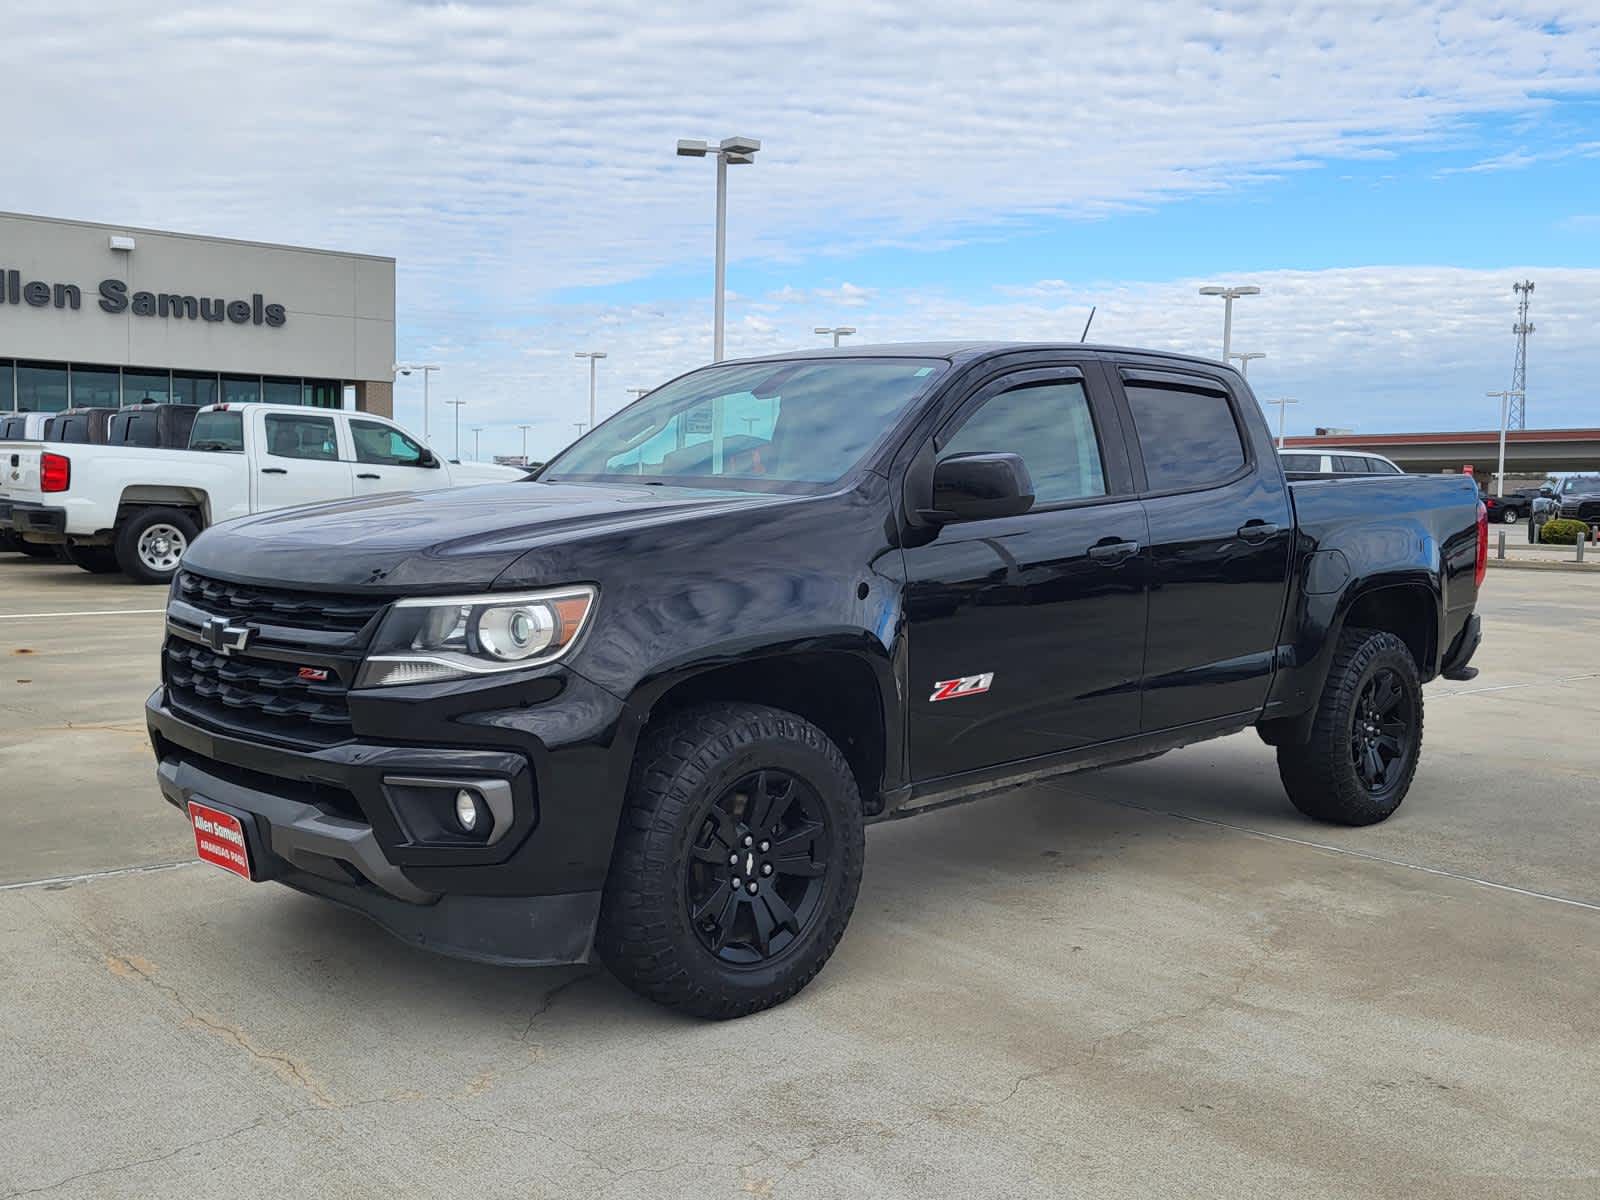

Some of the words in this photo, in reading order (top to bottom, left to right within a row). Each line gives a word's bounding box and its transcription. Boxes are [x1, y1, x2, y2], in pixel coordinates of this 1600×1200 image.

[98, 279, 287, 328] Samuels
[297, 667, 328, 681] Z71
[929, 672, 994, 701] Z71
[213, 822, 242, 847] Samuels
